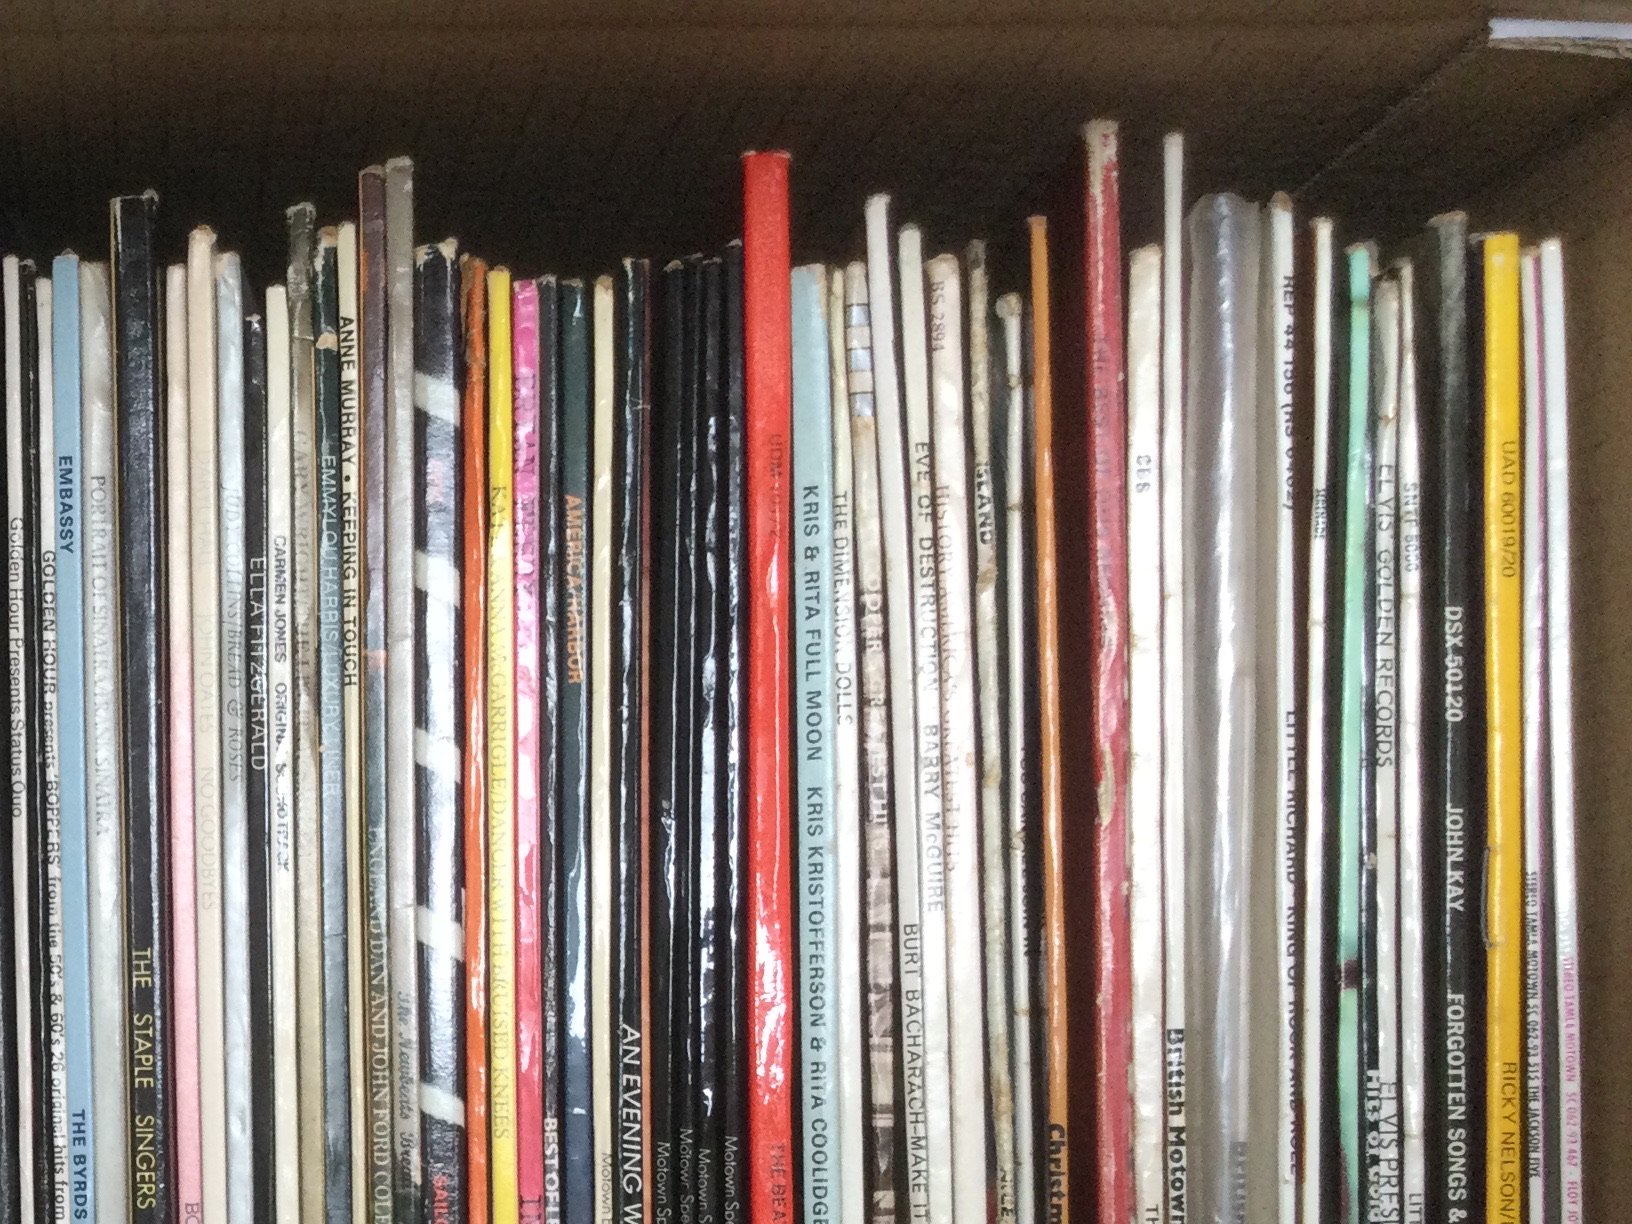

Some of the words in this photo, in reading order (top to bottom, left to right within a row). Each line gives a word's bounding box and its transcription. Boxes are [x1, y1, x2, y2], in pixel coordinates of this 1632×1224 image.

[1501, 441, 1516, 485] UAD
[59, 456, 74, 553] EMBASSY
[803, 485, 819, 537] KRIS
[804, 546, 819, 560] &
[1501, 492, 1516, 578] 60019/20
[805, 572, 820, 619] RITA
[805, 629, 821, 680] FULL
[806, 690, 822, 761] MOON
[807, 787, 823, 837] KRIS
[808, 846, 825, 1026] KRISTOFFERSON
[133, 948, 151, 988] THE
[134, 1014, 153, 1089] STAPLE
[622, 1025, 640, 1065] AN
[811, 1038, 826, 1051] &
[904, 924, 921, 974] BURT
[913, 1204, 929, 1220] IT
[1168, 1029, 1186, 1115] British
[1448, 994, 1466, 1119] FORGOTTEN
[811, 1062, 826, 1108] RITA
[1500, 1062, 1517, 1123] RICKY
[136, 1115, 155, 1208] SINGERS
[623, 1074, 642, 1194] EVENING
[1449, 1129, 1466, 1199] SONGS
[656, 1143, 671, 1202] Motown
[1449, 1207, 1466, 1221] &
